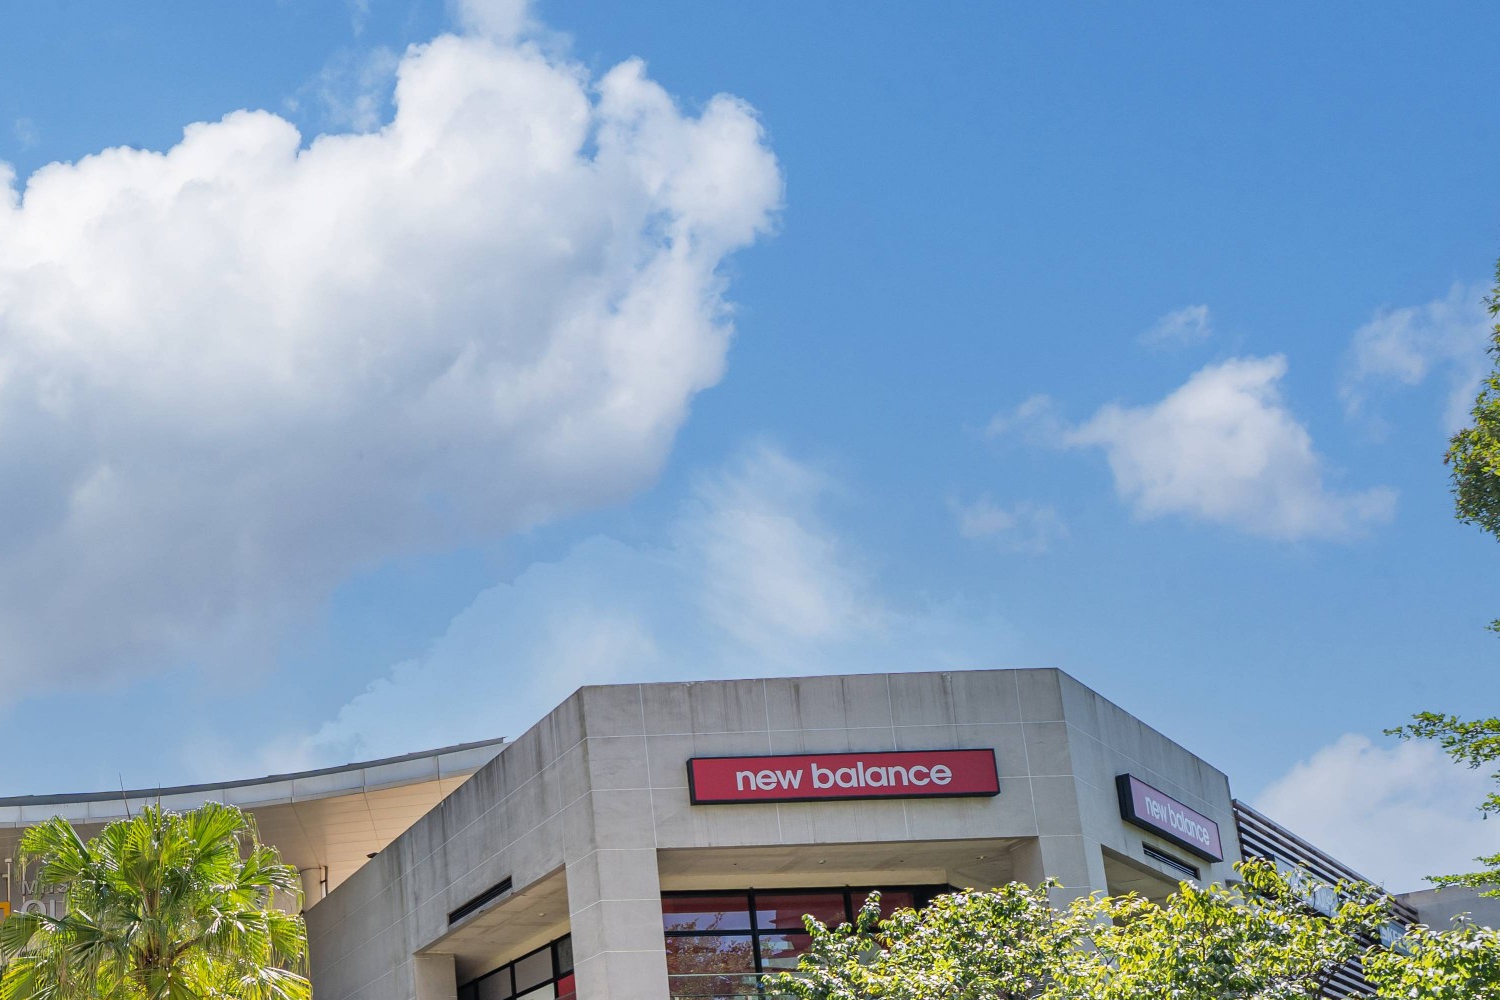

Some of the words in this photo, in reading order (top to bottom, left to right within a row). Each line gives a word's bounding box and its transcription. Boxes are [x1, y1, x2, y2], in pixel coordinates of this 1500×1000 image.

[736, 769, 803, 791] new
[811, 761, 952, 789] balance
[1145, 796, 1167, 824] new
[1168, 803, 1210, 846] balance
